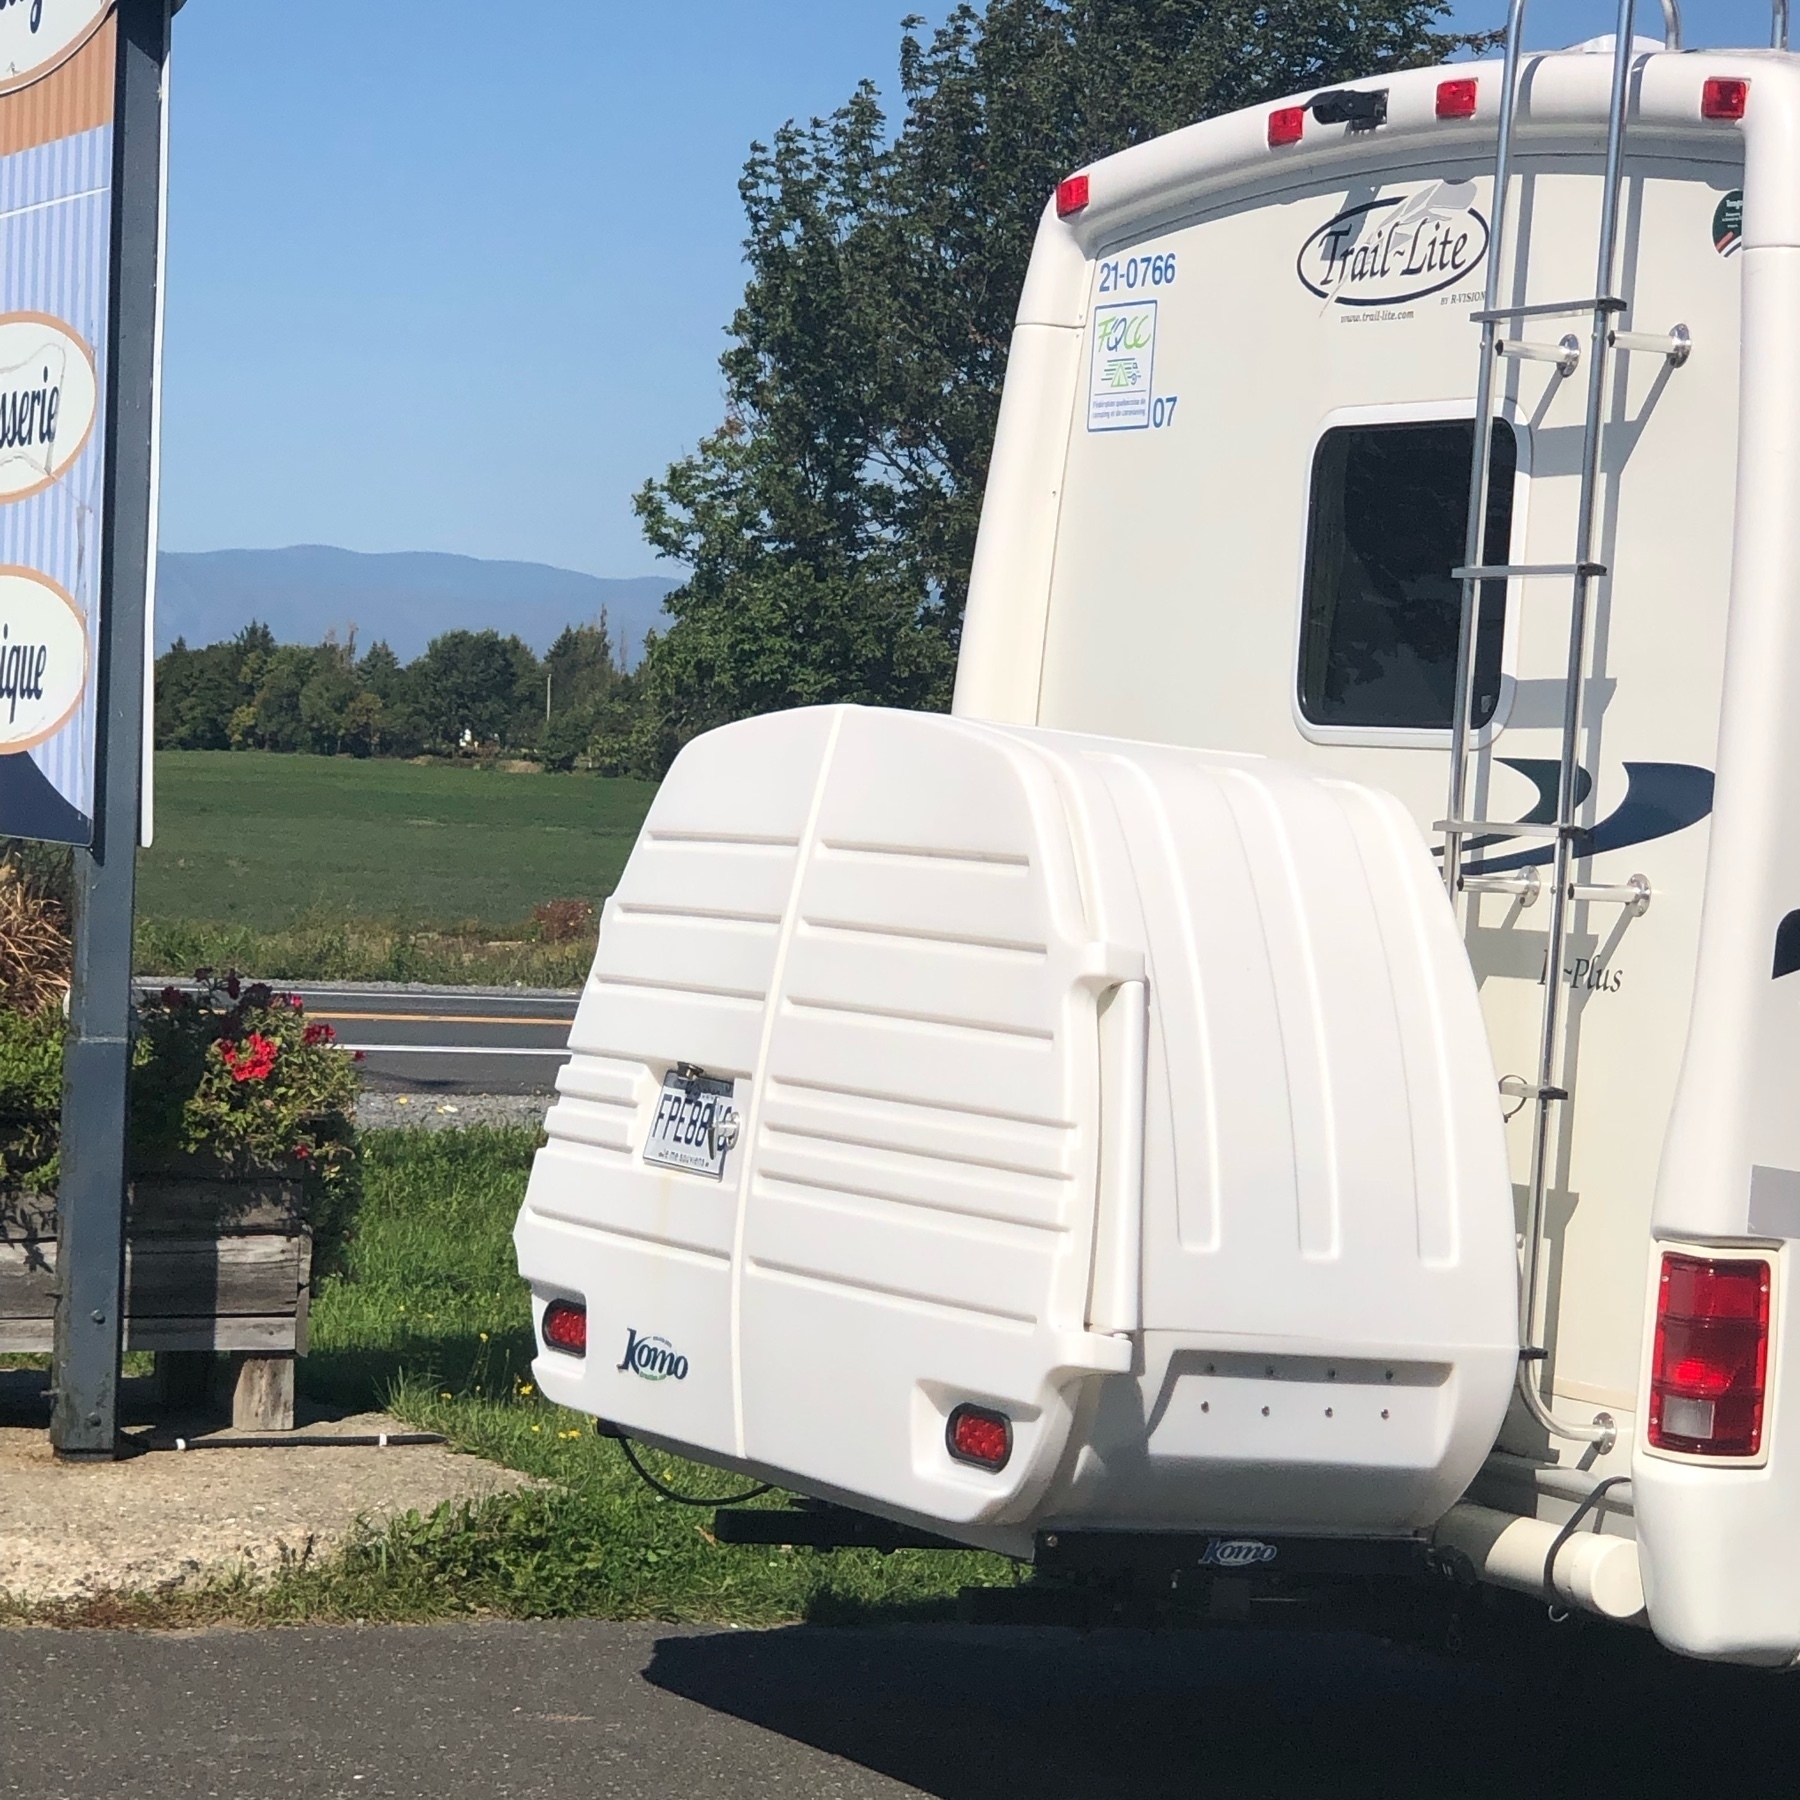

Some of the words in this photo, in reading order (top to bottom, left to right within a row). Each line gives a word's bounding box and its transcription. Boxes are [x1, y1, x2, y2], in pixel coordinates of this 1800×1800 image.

[1099, 253, 1176, 292] 21-0766
[1340, 309, 1414, 324] www.trail-lite.com
[1152, 396, 1178, 429] 07
[616, 1327, 689, 1380] Komo
[1197, 1538, 1277, 1566] Komo
